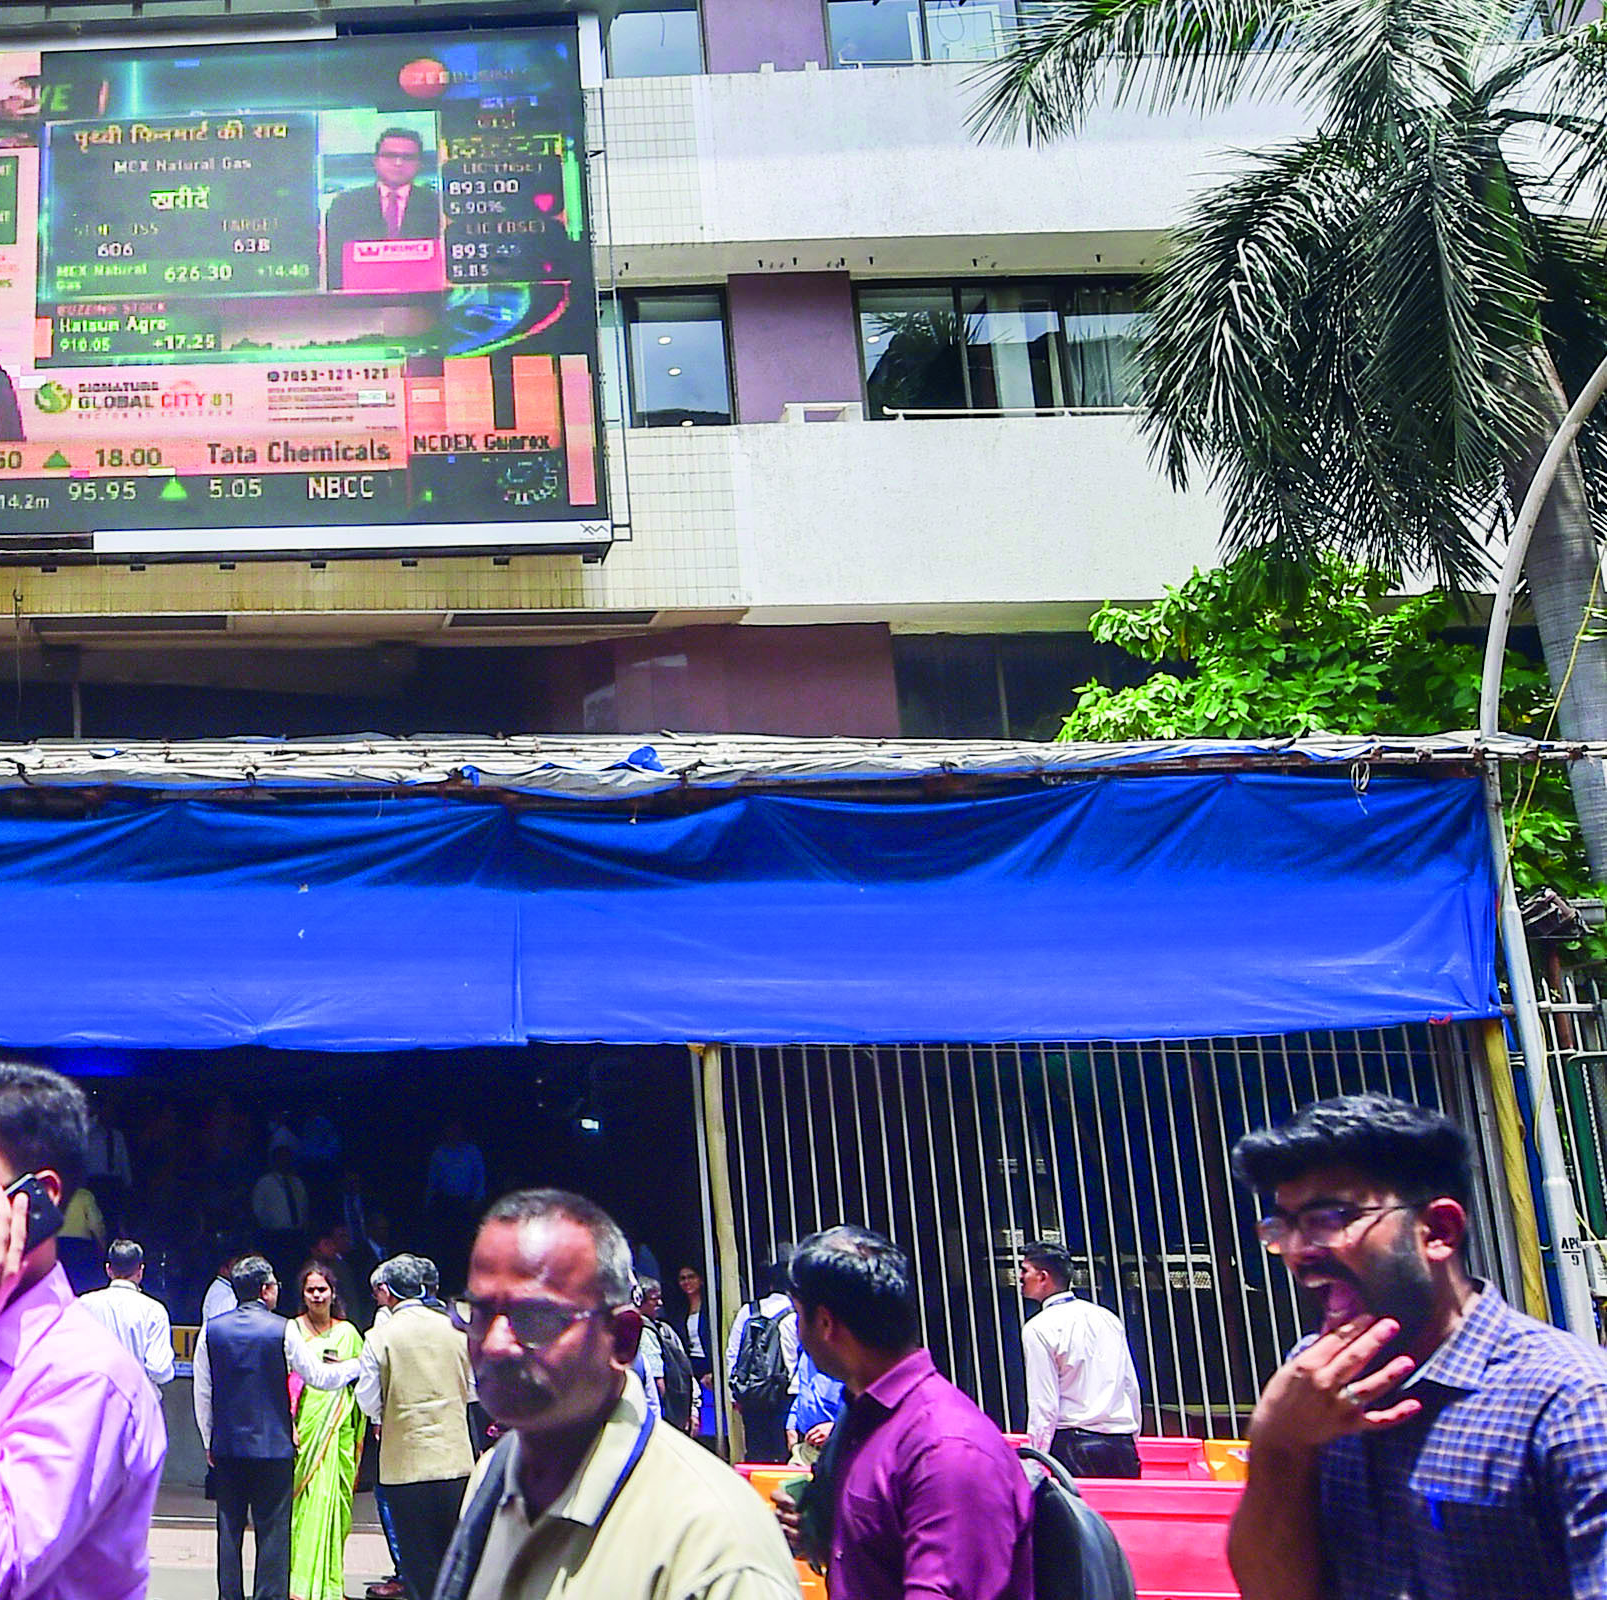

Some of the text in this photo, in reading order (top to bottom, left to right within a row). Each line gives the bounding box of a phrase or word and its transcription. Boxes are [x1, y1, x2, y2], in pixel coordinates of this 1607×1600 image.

[217, 119, 244, 141] की
[113, 156, 252, 174] MCX Natural Gas
[448, 178, 520, 196] 893.00
[149, 184, 211, 211] खरीदें
[97, 241, 135, 258] 606
[94, 262, 149, 276] Natural
[163, 264, 234, 284] 626.30
[55, 278, 83, 291] Gas
[126, 315, 168, 335] Agro
[152, 333, 216, 351] +17.25
[78, 394, 155, 410] GLOBAL
[161, 392, 208, 409] CITY
[95, 447, 163, 468] 18.00
[207, 442, 258, 466] Tata
[266, 436, 392, 463] Chemicals
[68, 480, 137, 501] 95.95
[208, 477, 263, 499] 5.05
[307, 475, 375, 500] NBCC
